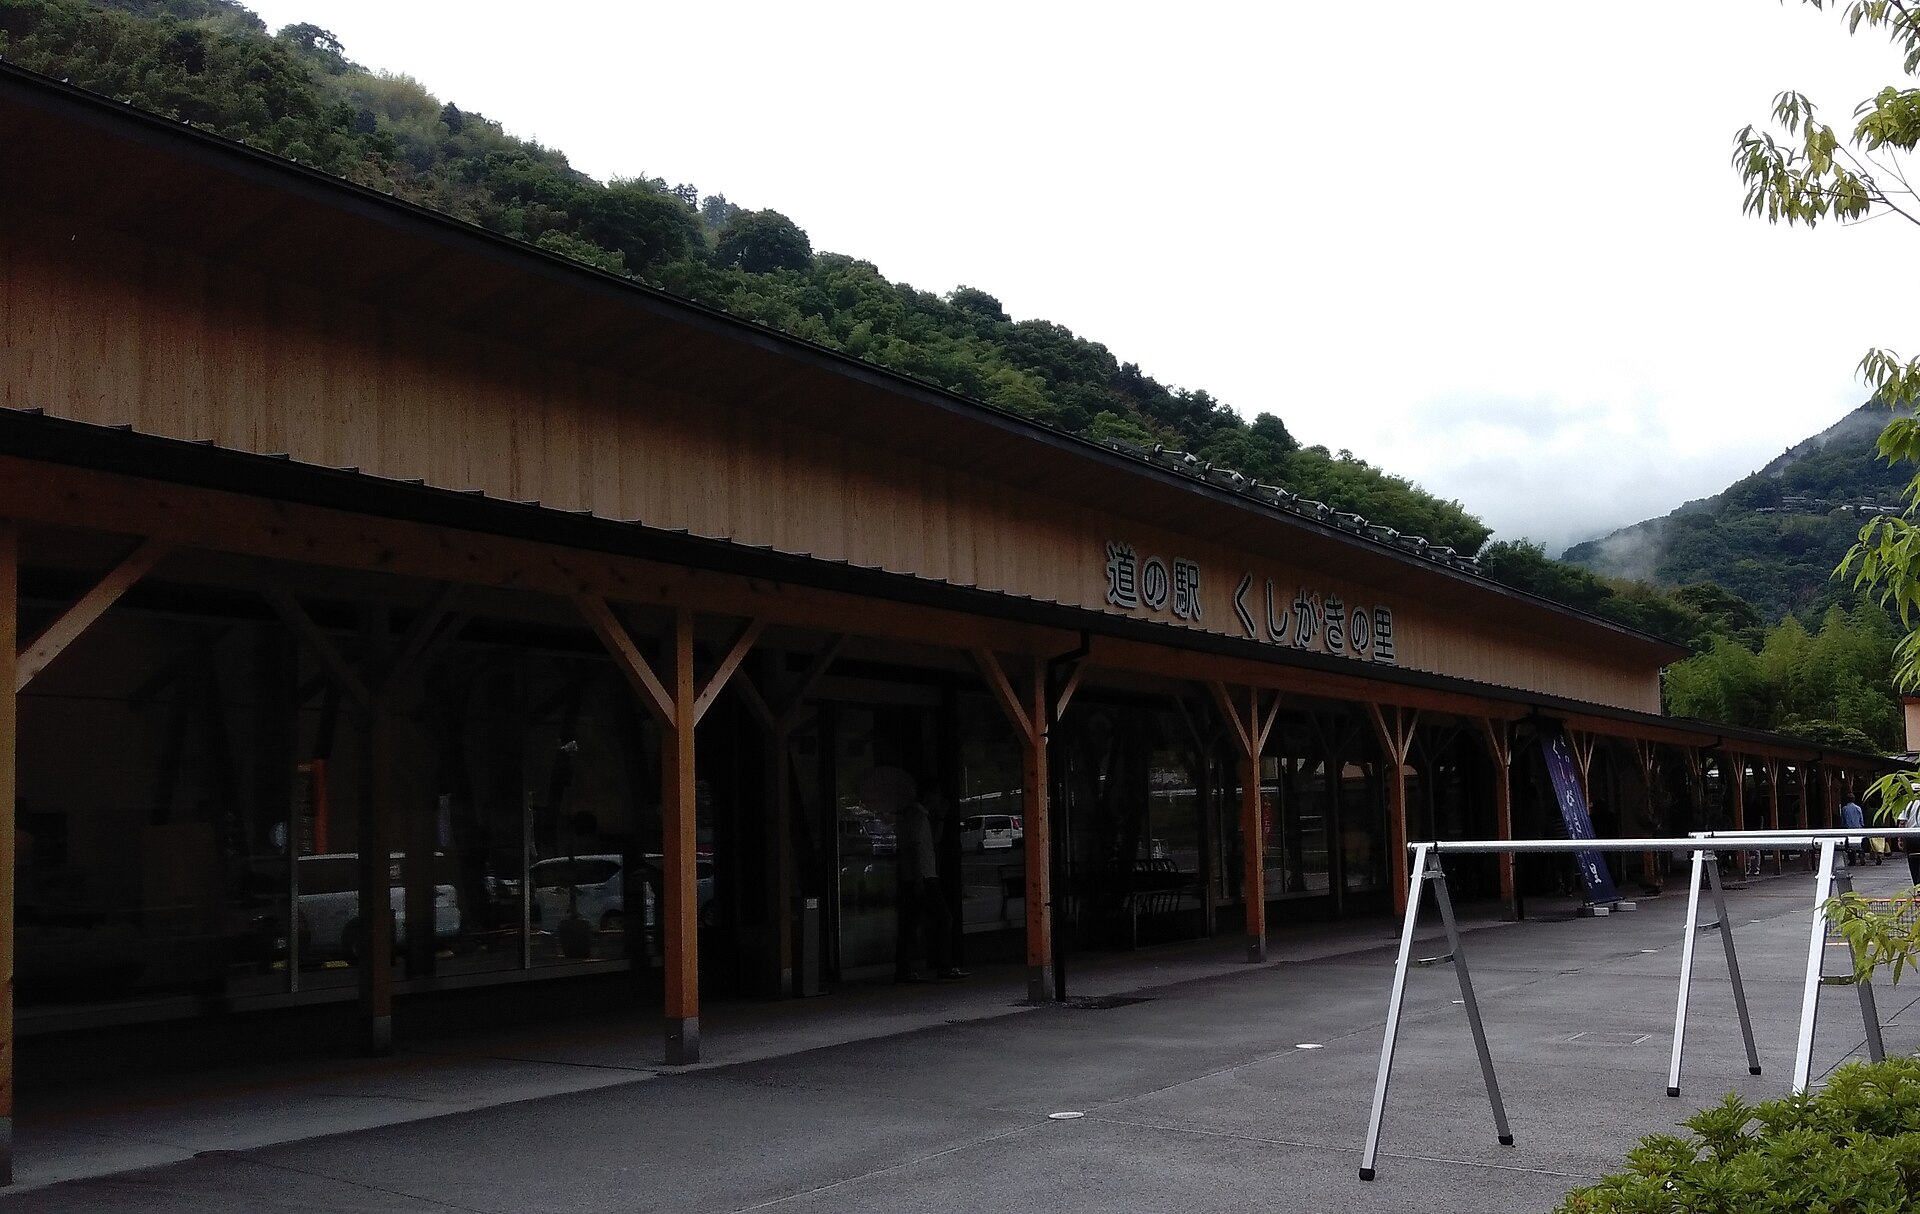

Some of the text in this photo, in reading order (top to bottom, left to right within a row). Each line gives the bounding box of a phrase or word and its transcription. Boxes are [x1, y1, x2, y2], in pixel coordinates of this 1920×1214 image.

[1105, 540, 1396, 665] 道の駅 くしがきの里
